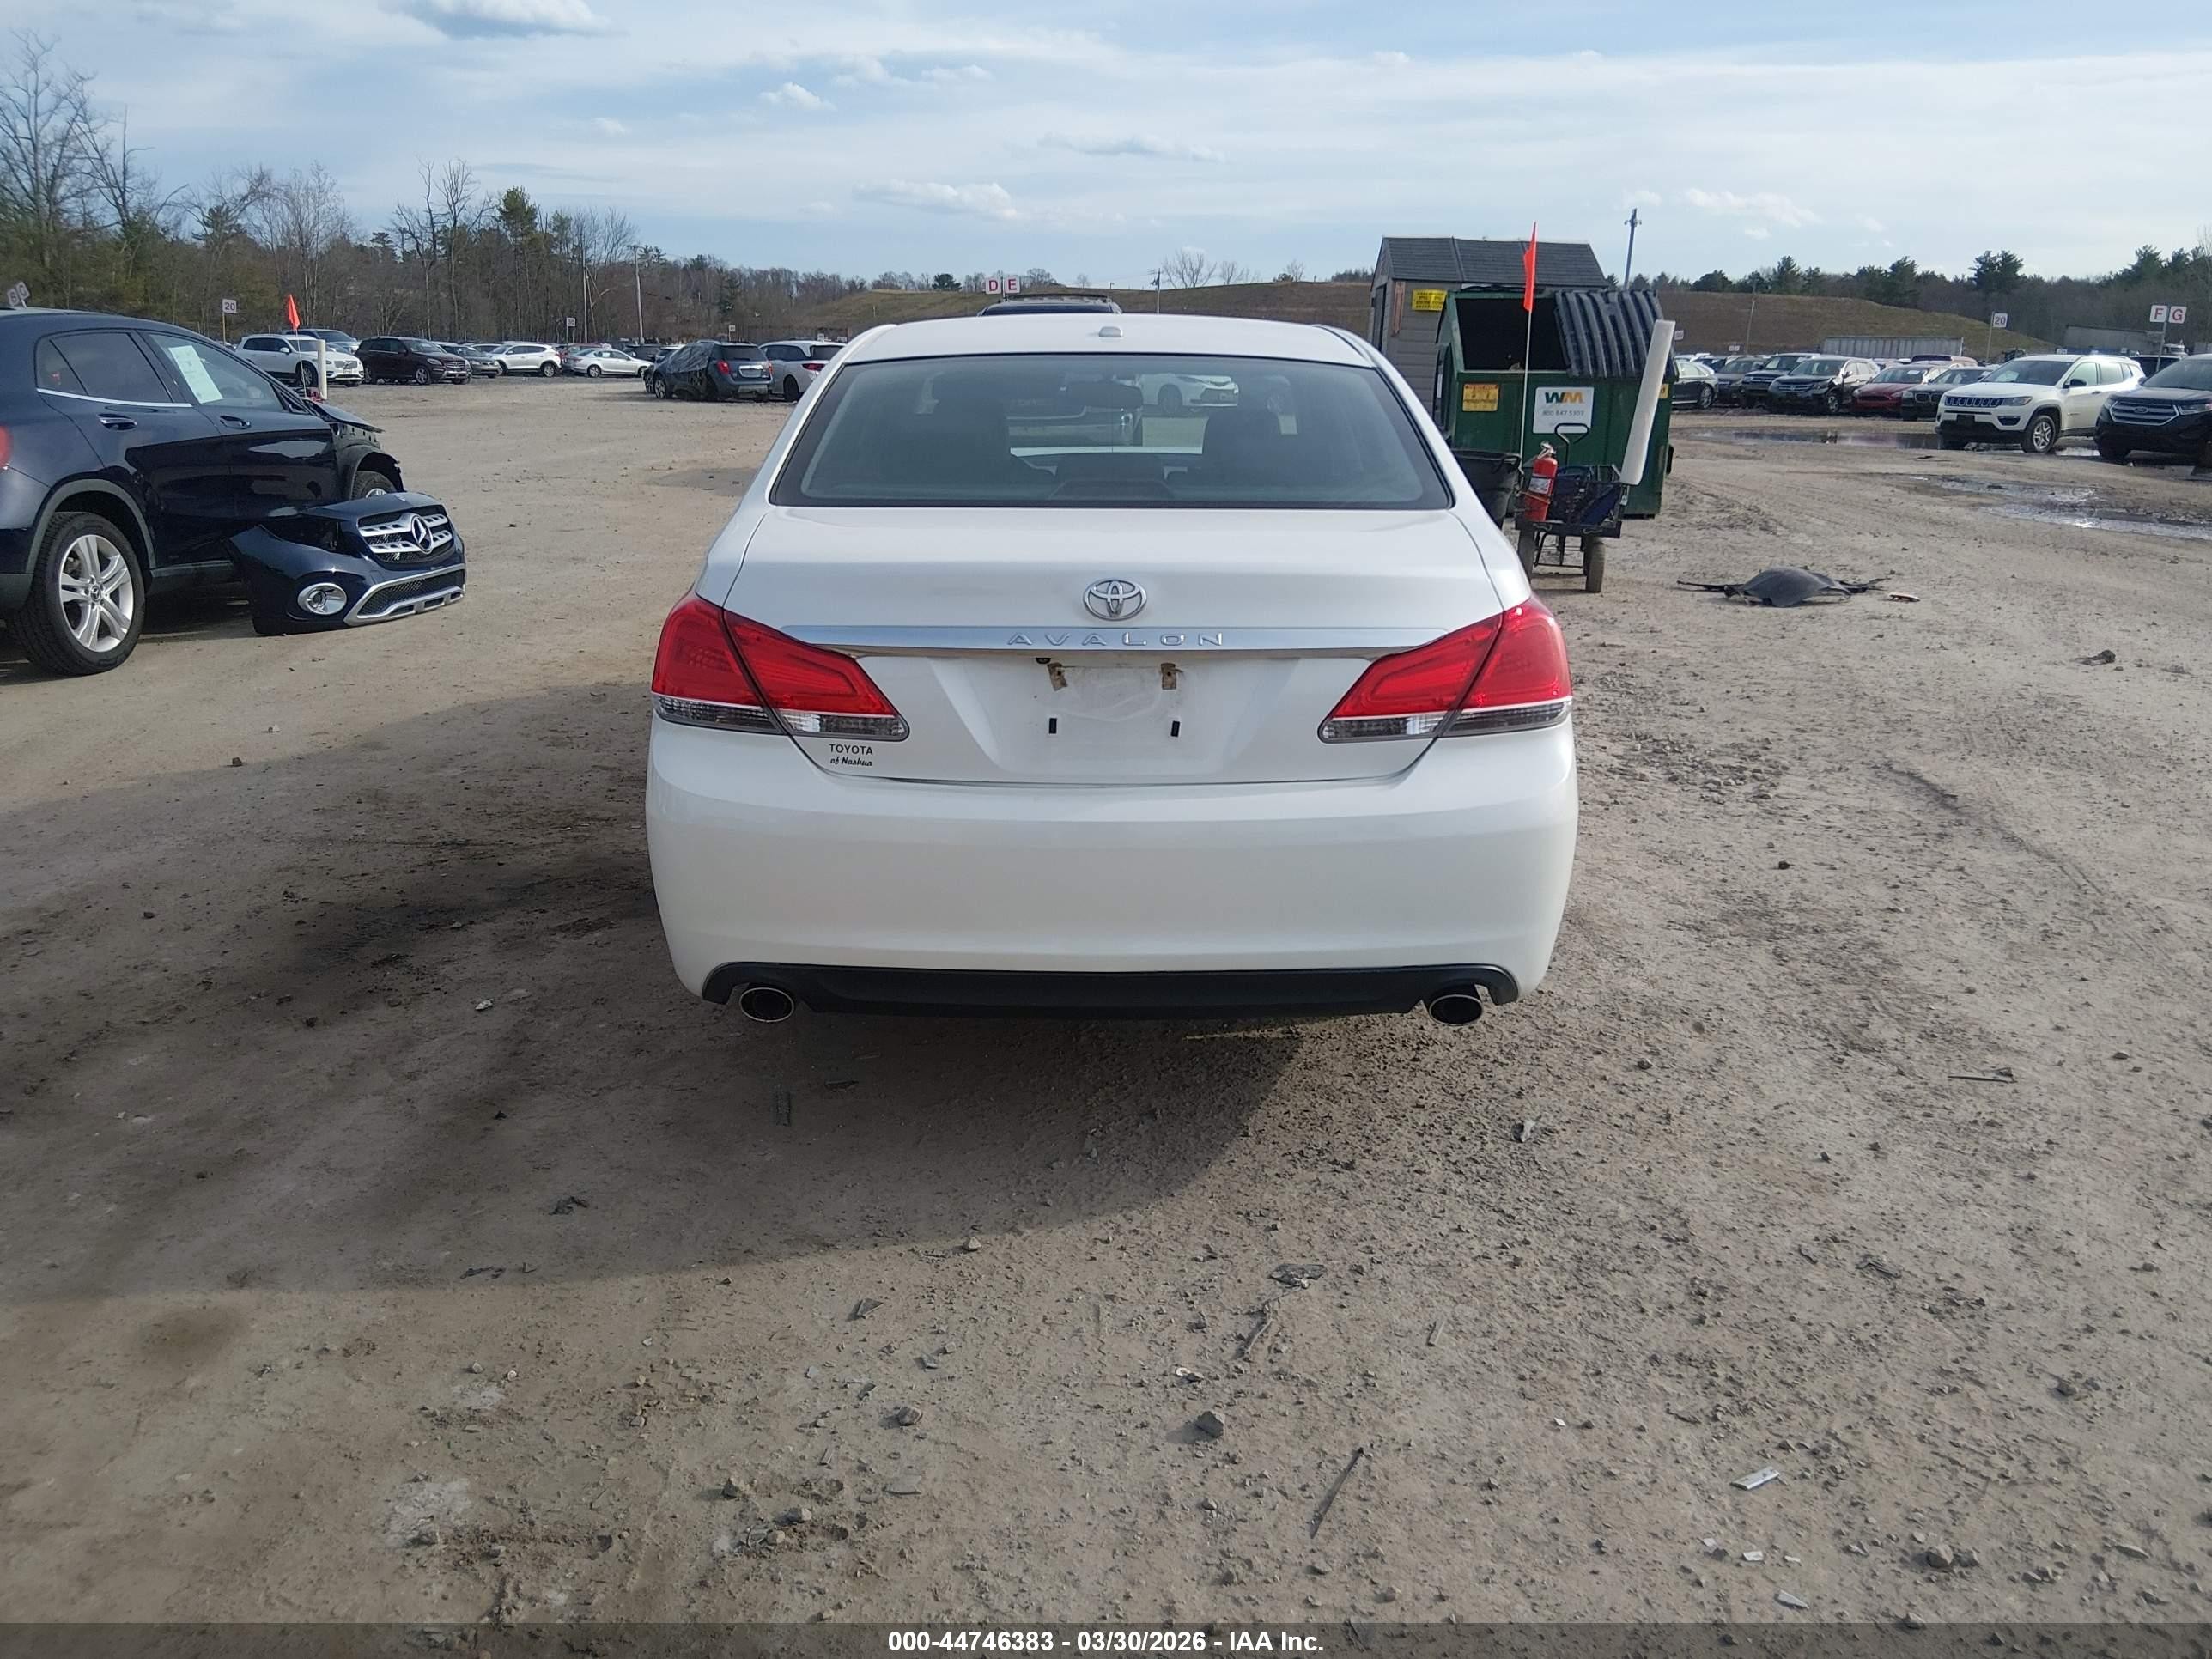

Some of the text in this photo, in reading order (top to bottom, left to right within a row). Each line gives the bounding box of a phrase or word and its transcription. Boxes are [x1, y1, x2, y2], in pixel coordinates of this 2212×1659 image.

[988, 279, 999, 292] D
[1007, 278, 1018, 291] E
[224, 301, 235, 311] 20
[1994, 315, 2006, 325] 20
[2154, 307, 2164, 320] F
[2172, 308, 2184, 321] G
[1545, 392, 1584, 404] WM
[1007, 631, 1224, 647] AVALON
[829, 743, 873, 756] TOYOTA
[830, 756, 873, 767] of Nashua
